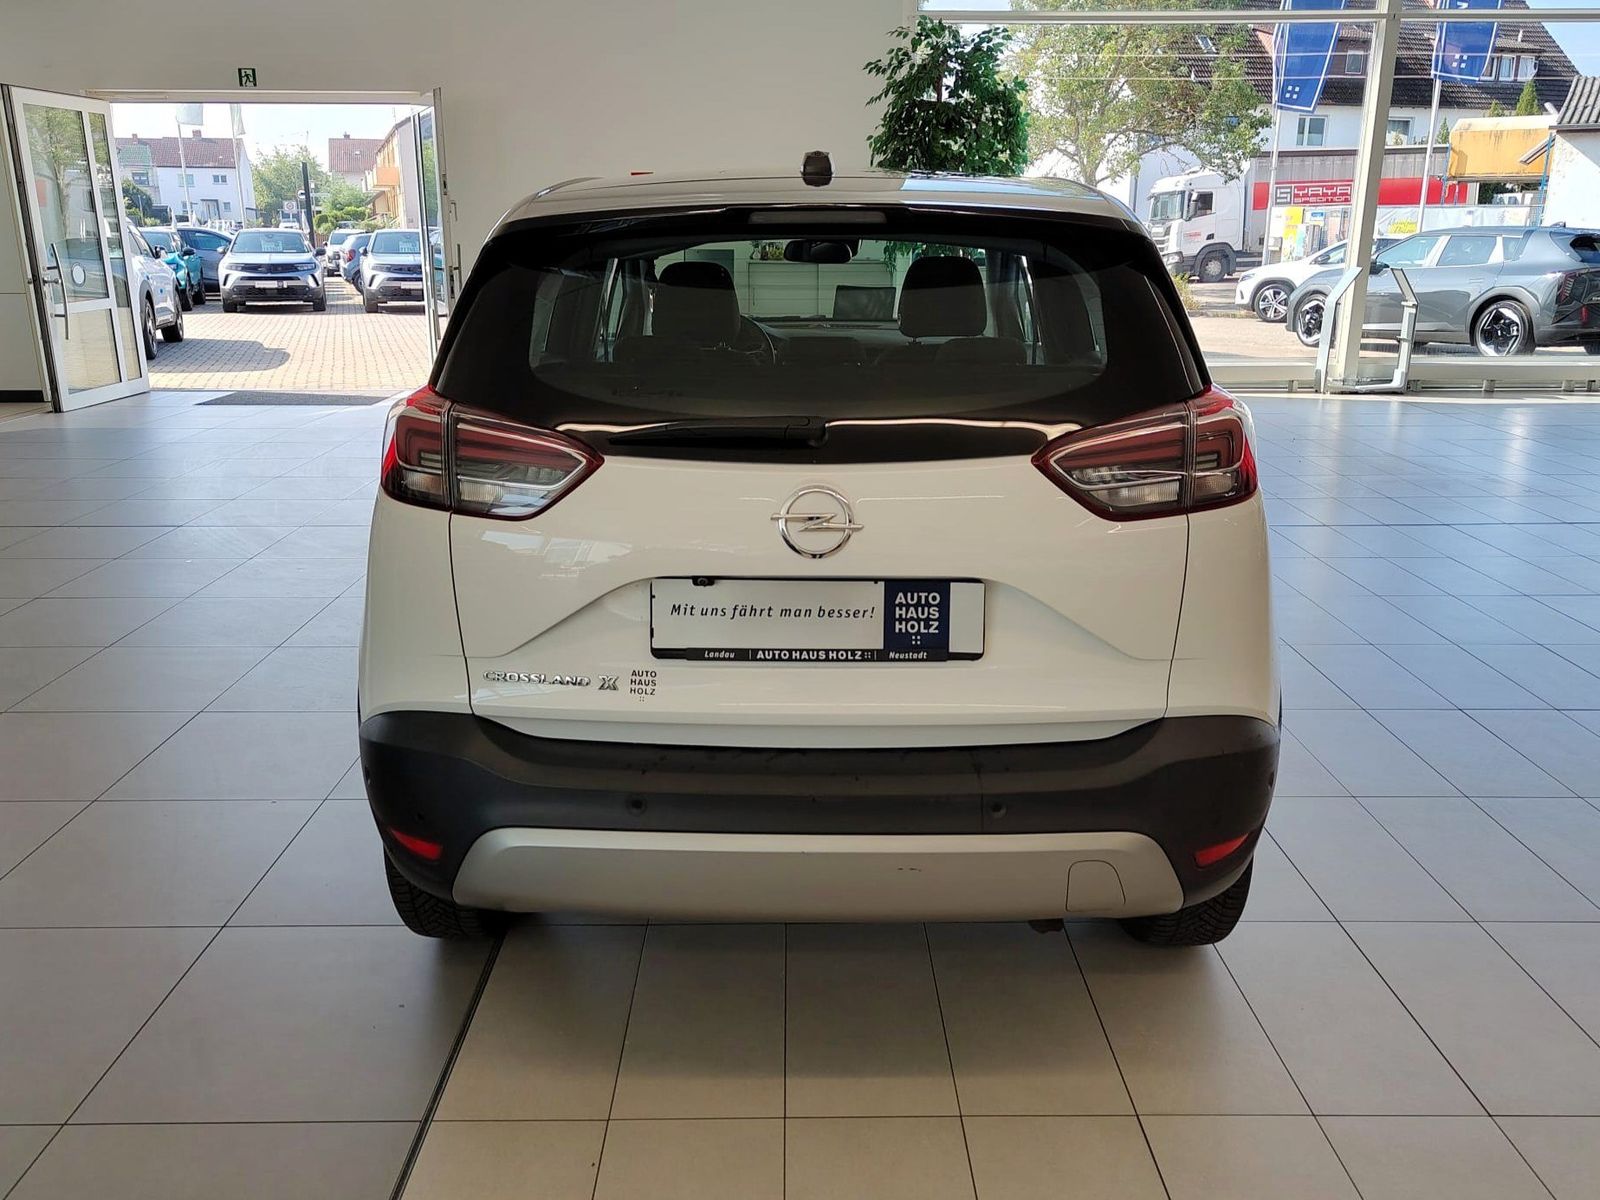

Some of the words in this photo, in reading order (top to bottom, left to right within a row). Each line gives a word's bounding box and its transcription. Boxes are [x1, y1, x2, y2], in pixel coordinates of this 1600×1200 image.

[1295, 186, 1351, 197] YAYA
[895, 592, 941, 605] AUTO
[670, 604, 695, 617] Mit
[701, 606, 727, 618] uns
[730, 604, 773, 620] fährt
[779, 607, 812, 619] man
[817, 606, 875, 619] besser!
[895, 606, 939, 619] HAUS
[895, 621, 939, 634] HOLZ
[704, 649, 735, 659] Landau
[889, 651, 928, 660] Neustadt
[631, 669, 657, 678] AUTO
[483, 671, 591, 687] CROSSLAND
[598, 675, 619, 691] X
[630, 678, 657, 686] HAUS
[629, 687, 656, 696] HOLZ
